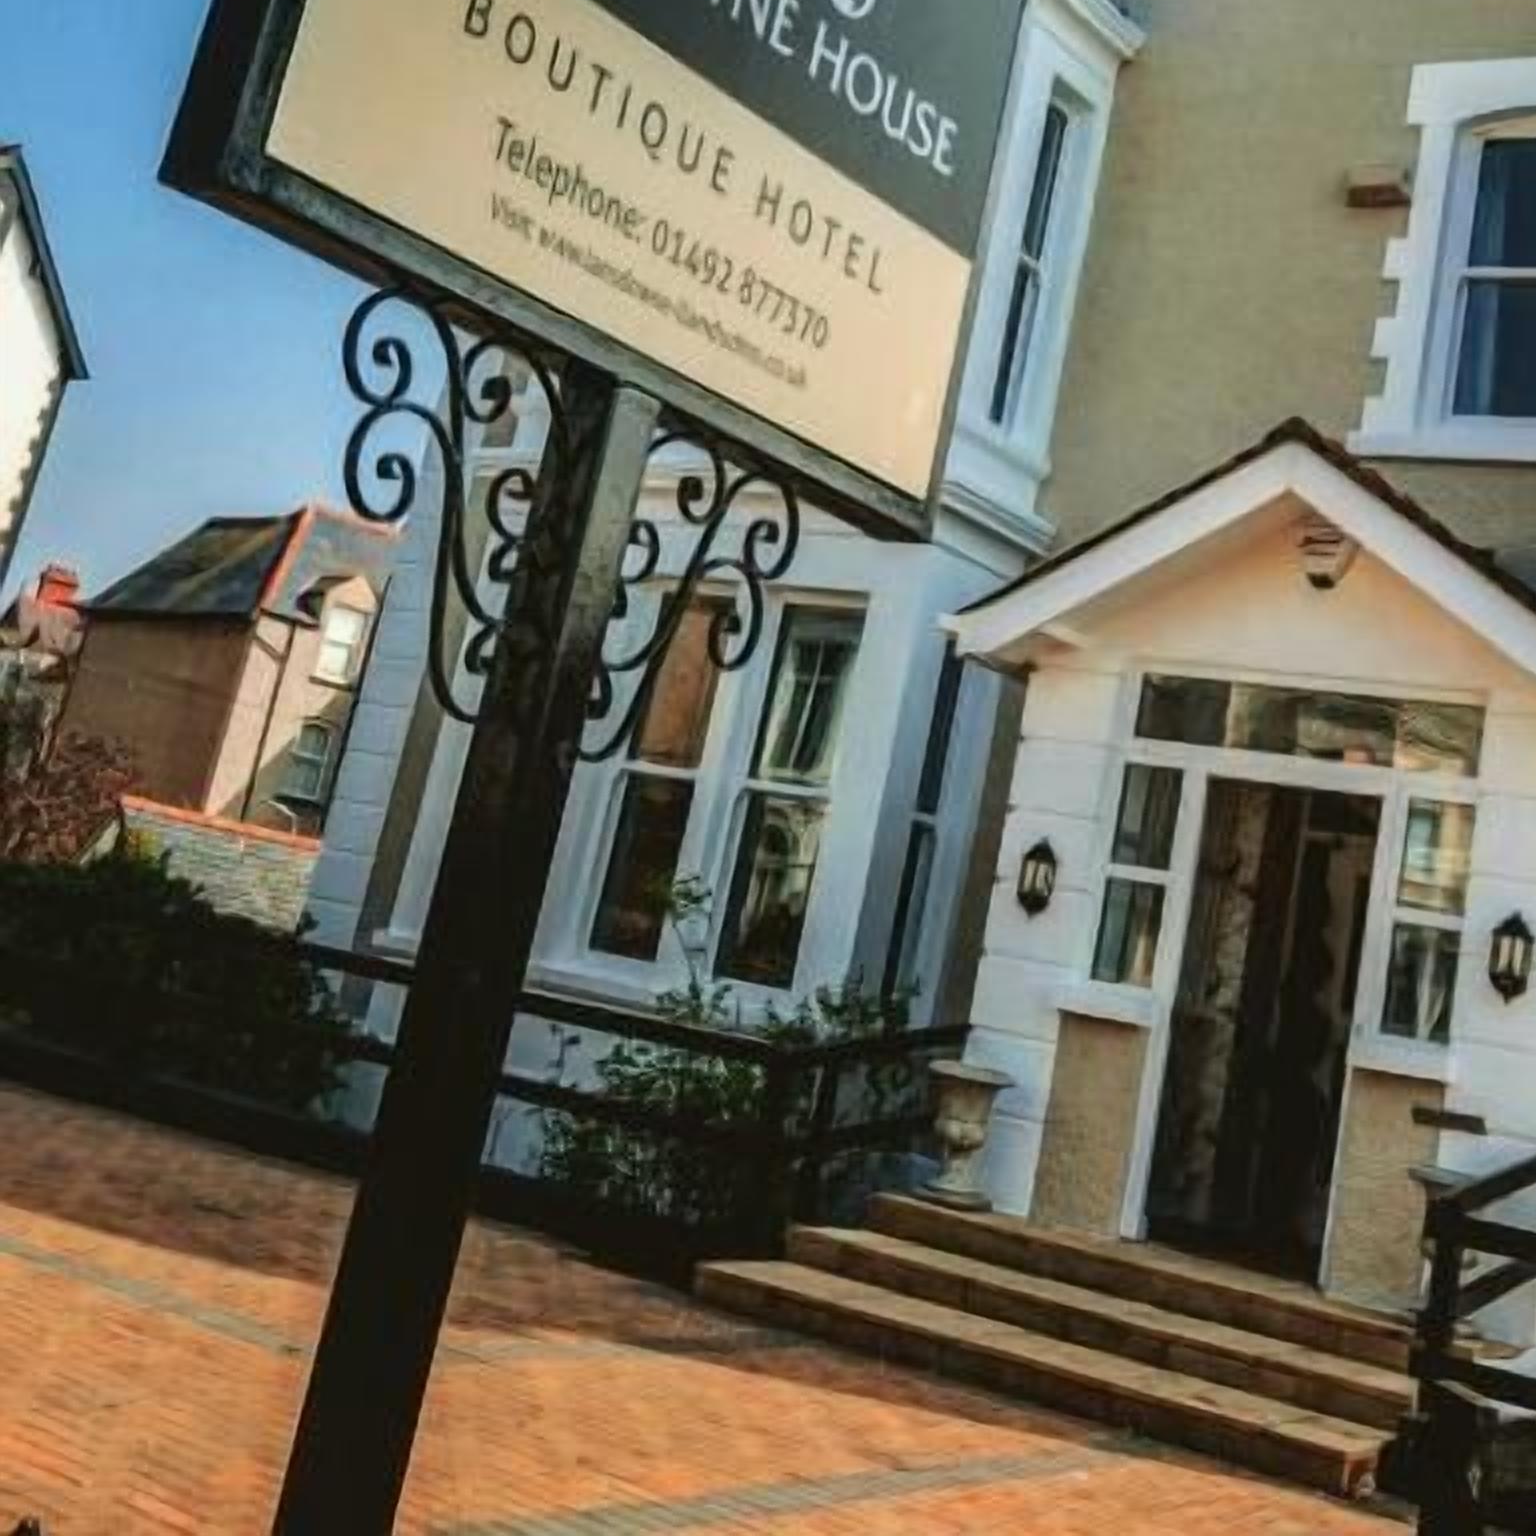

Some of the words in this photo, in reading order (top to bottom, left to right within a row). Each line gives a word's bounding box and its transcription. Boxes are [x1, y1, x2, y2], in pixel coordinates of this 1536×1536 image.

[808, 19, 959, 177] HOUSE
[496, 115, 648, 244] Telephone:
[652, 219, 734, 295] 01492
[739, 266, 828, 348] 877370
[755, 173, 882, 295] HOTEL
